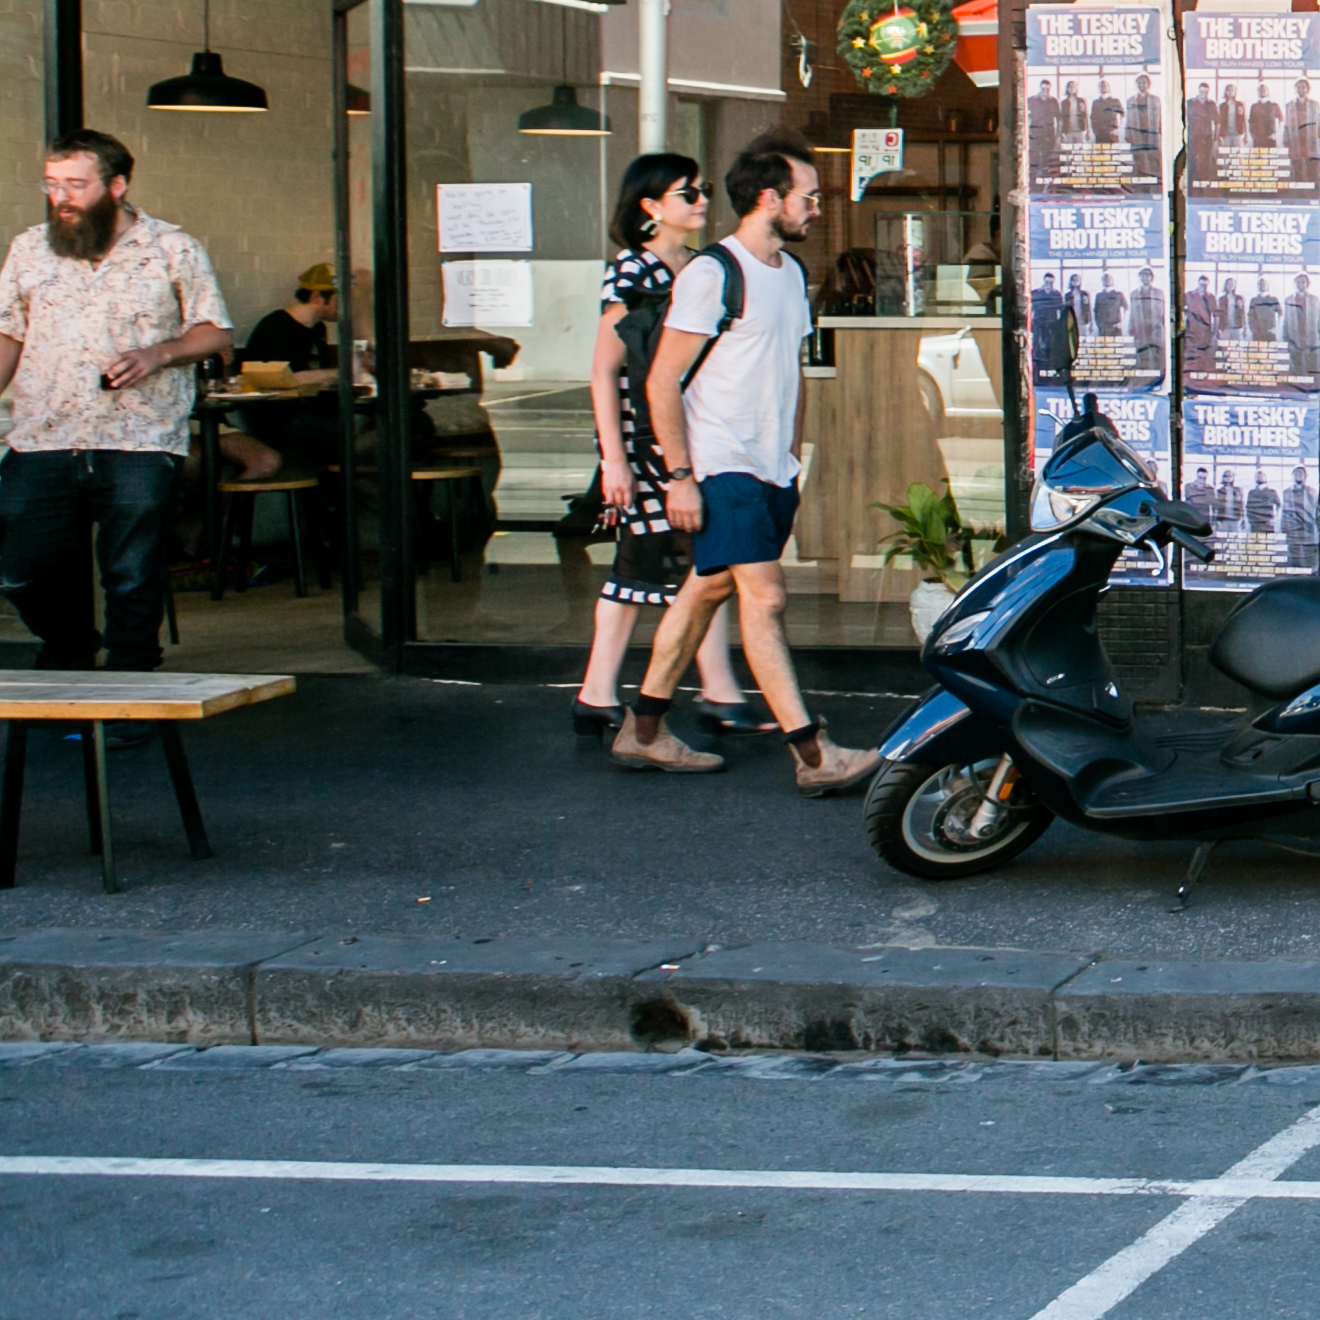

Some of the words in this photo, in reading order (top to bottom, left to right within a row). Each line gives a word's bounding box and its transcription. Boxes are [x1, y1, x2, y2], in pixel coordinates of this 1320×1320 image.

[1037, 14, 1074, 35] THE
[1077, 13, 1150, 35] TESKEY
[1197, 17, 1234, 38] THE
[1238, 18, 1311, 39] TESKEY
[1046, 35, 1143, 56] BROTHERS
[1206, 38, 1303, 60] BROTHERS
[1041, 209, 1078, 229] THE
[1081, 208, 1153, 228] TESKEY
[1198, 212, 1235, 233] THE
[1238, 212, 1311, 234] TESKEY
[1049, 228, 1146, 249] BROTHERS
[1205, 233, 1303, 254] BROTHERS
[1095, 399, 1159, 420] ESKEY
[1194, 404, 1230, 425] THE
[1234, 406, 1308, 426] TESKEY
[1203, 425, 1300, 447] BROTHERS
